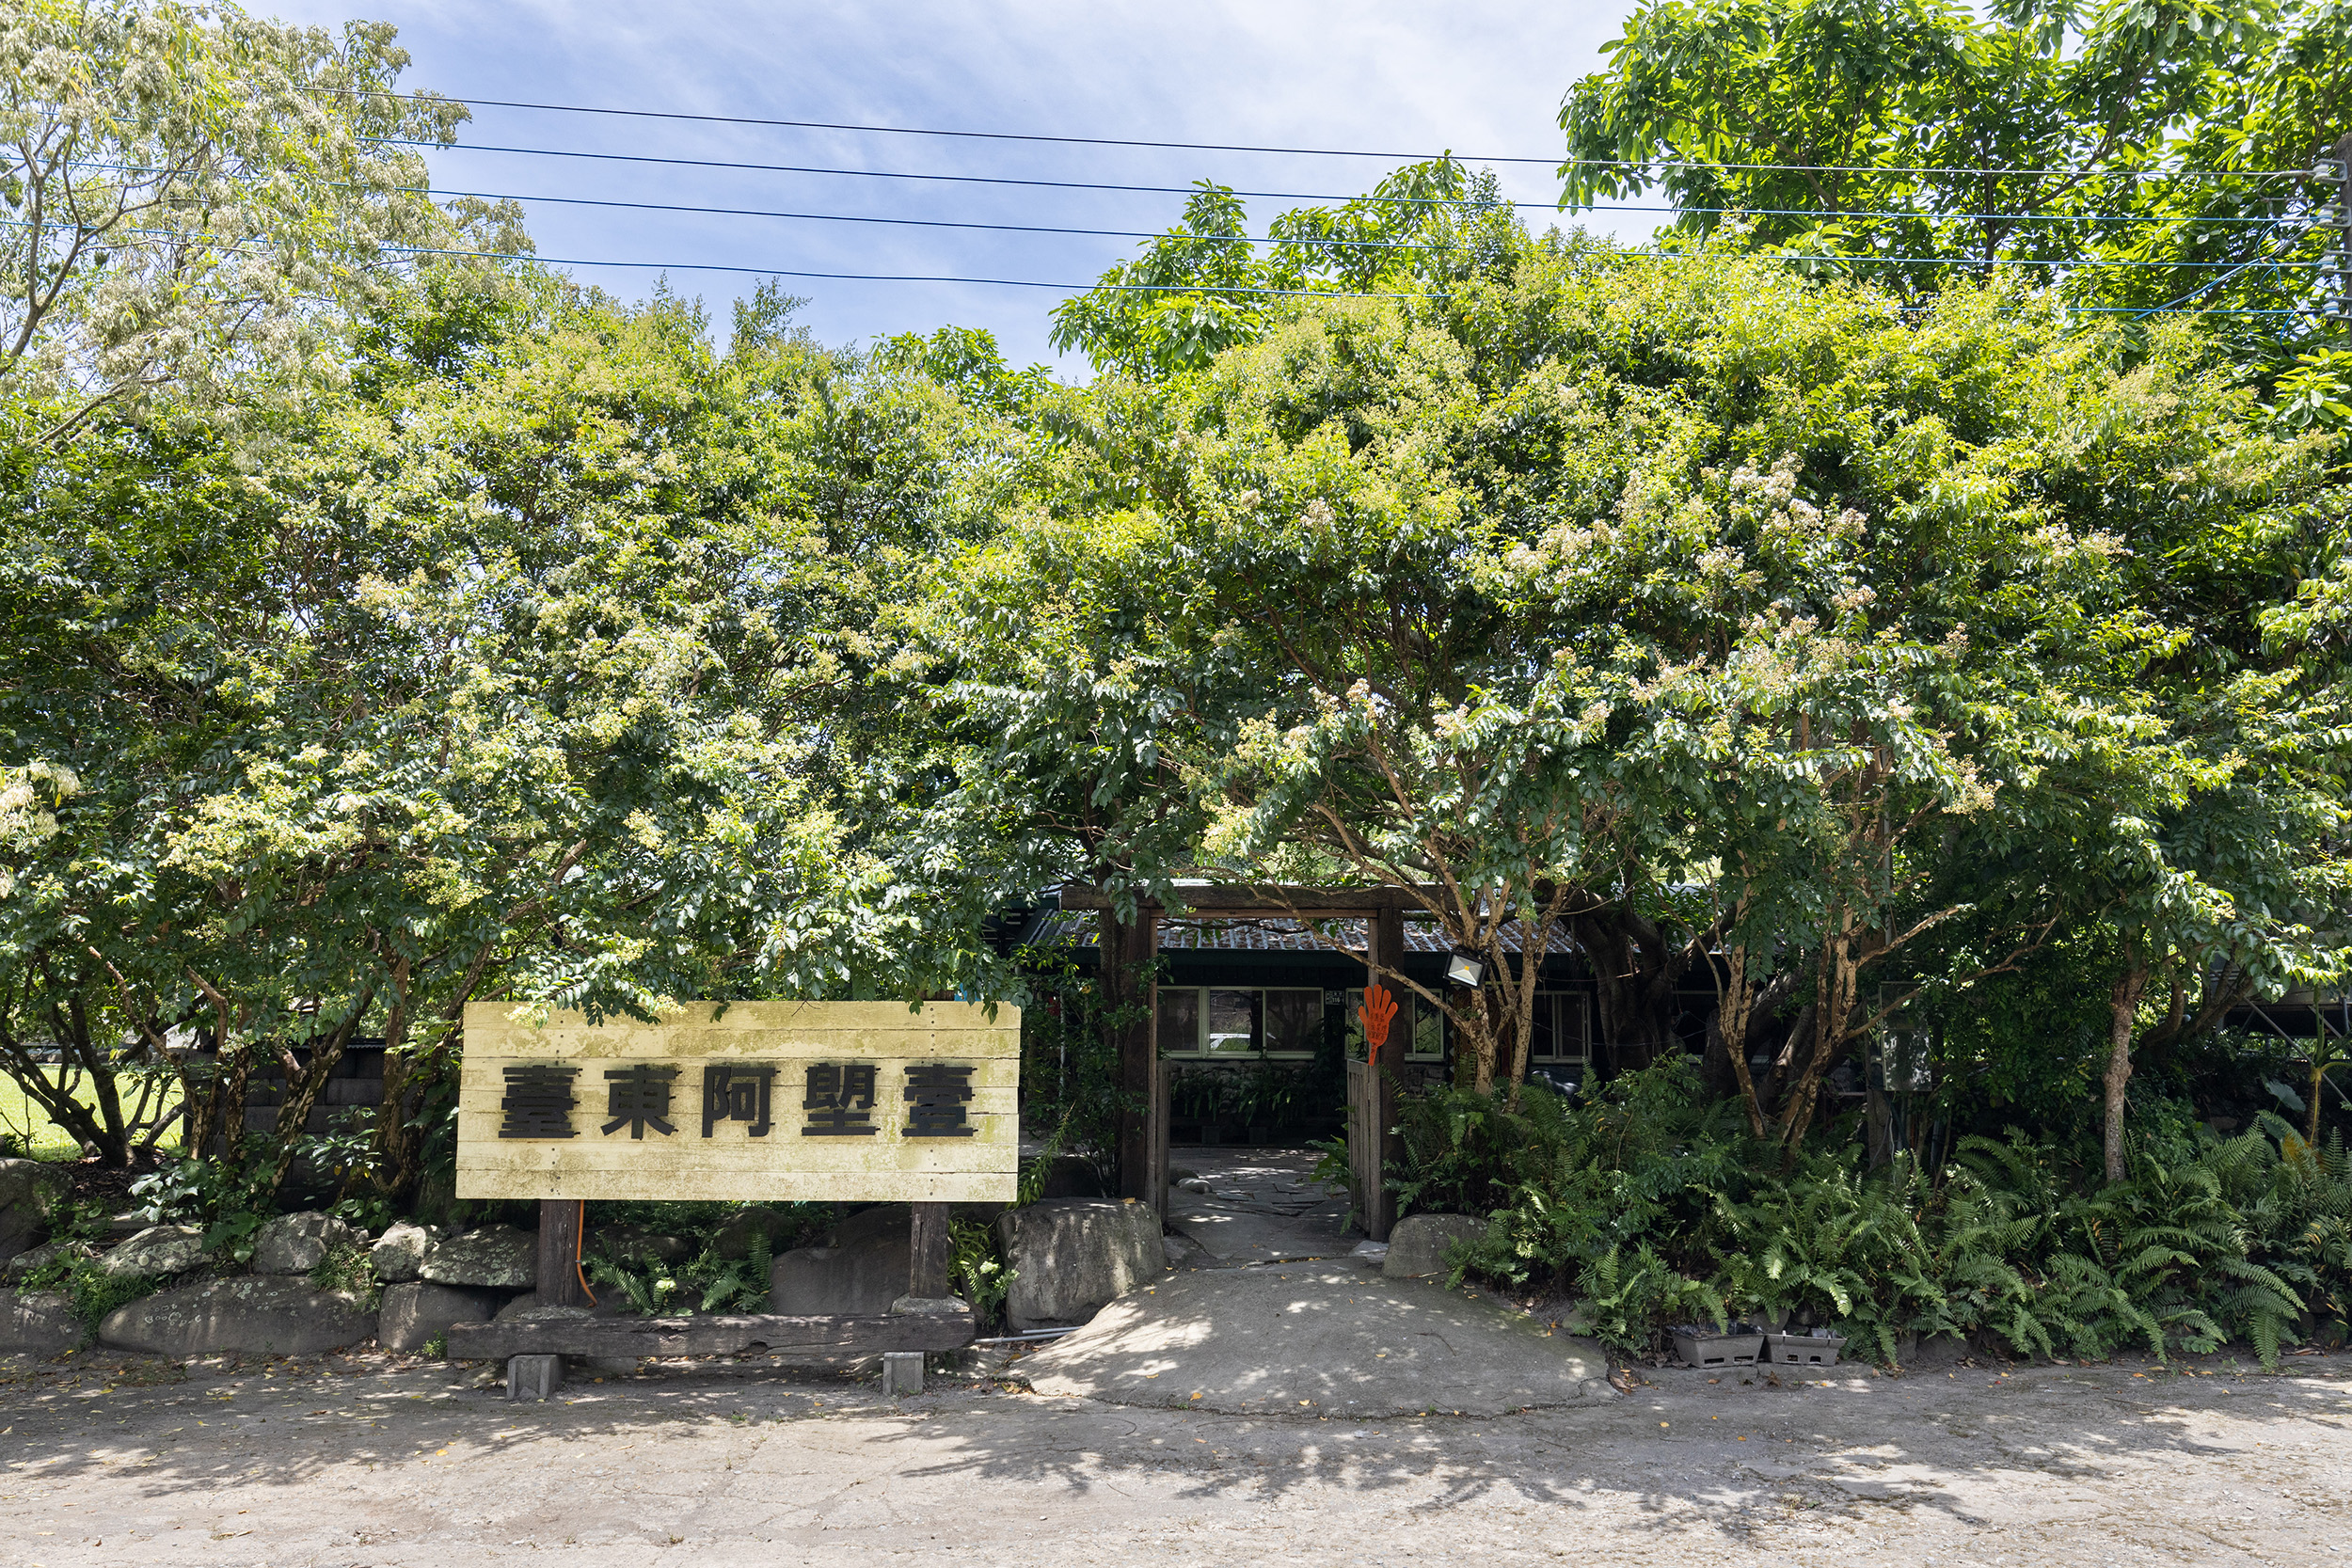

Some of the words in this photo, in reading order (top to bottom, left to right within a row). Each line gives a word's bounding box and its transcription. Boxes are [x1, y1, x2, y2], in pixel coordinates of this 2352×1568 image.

[498, 1063, 974, 1139] 臺東阿塱壹
